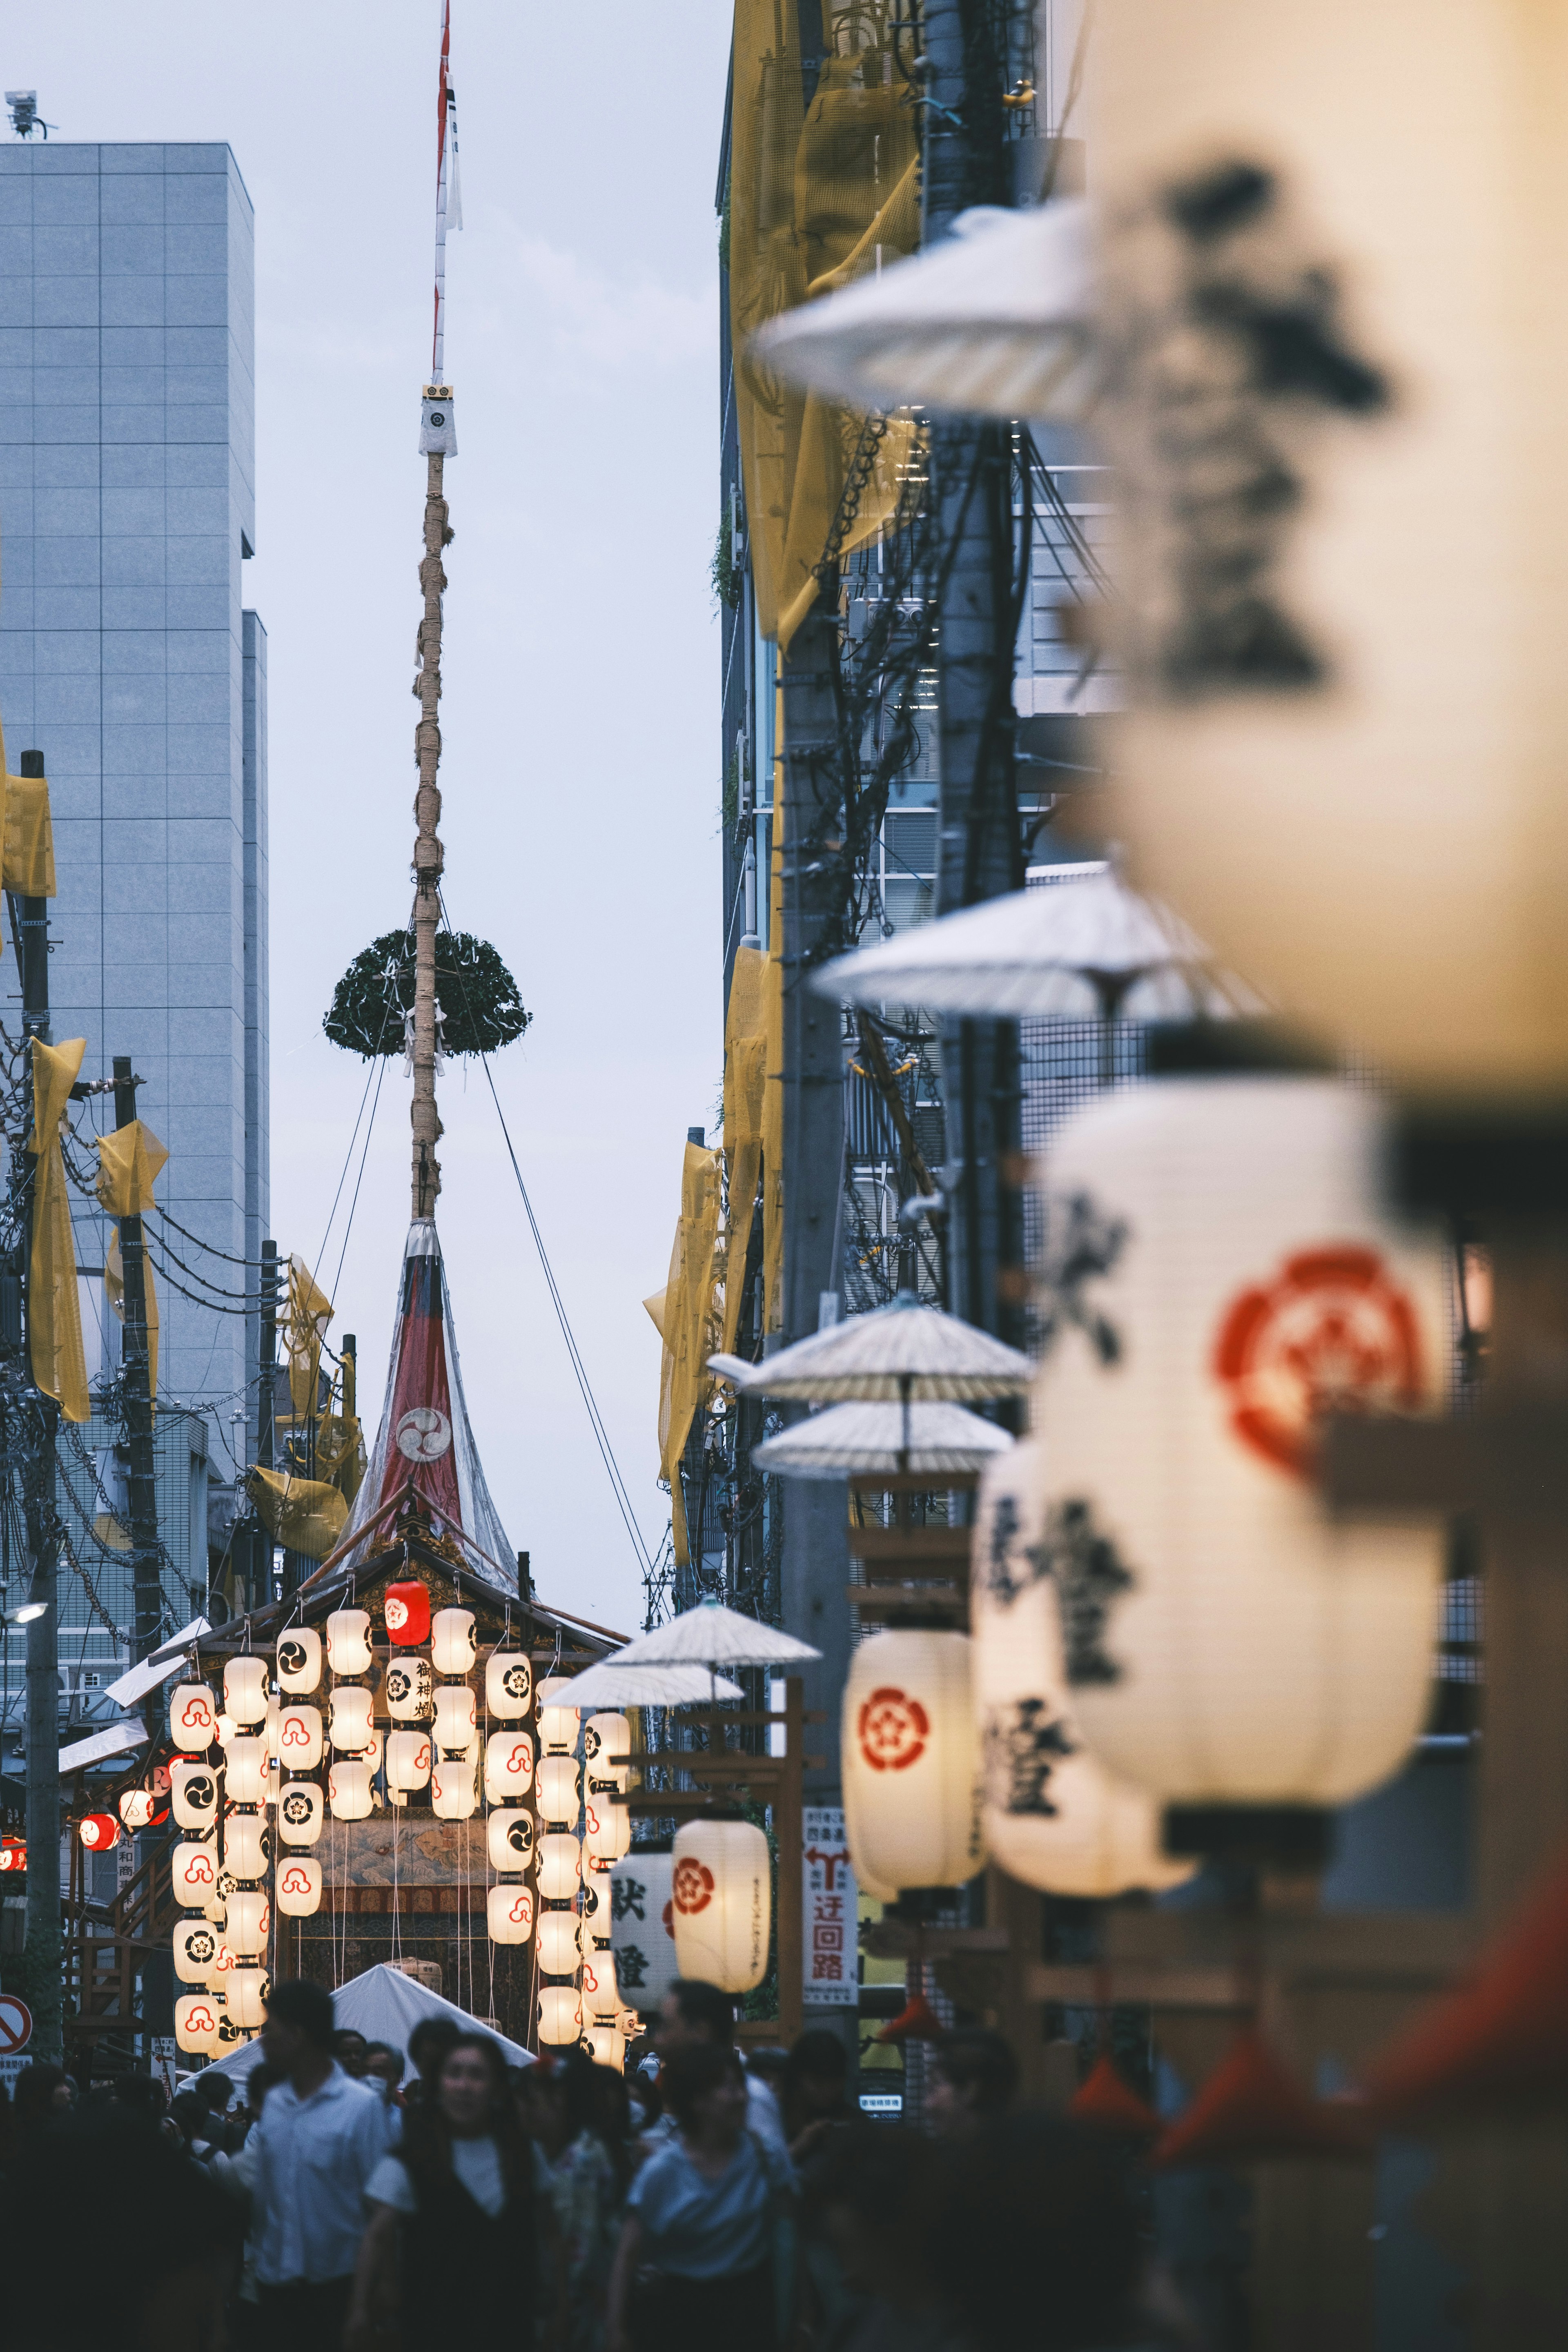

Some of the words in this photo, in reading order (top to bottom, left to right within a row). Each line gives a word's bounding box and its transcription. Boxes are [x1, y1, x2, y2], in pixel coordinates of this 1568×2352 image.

[119, 1837, 133, 1911] 丸和商事
[812, 1895, 844, 1980] 迂回路
